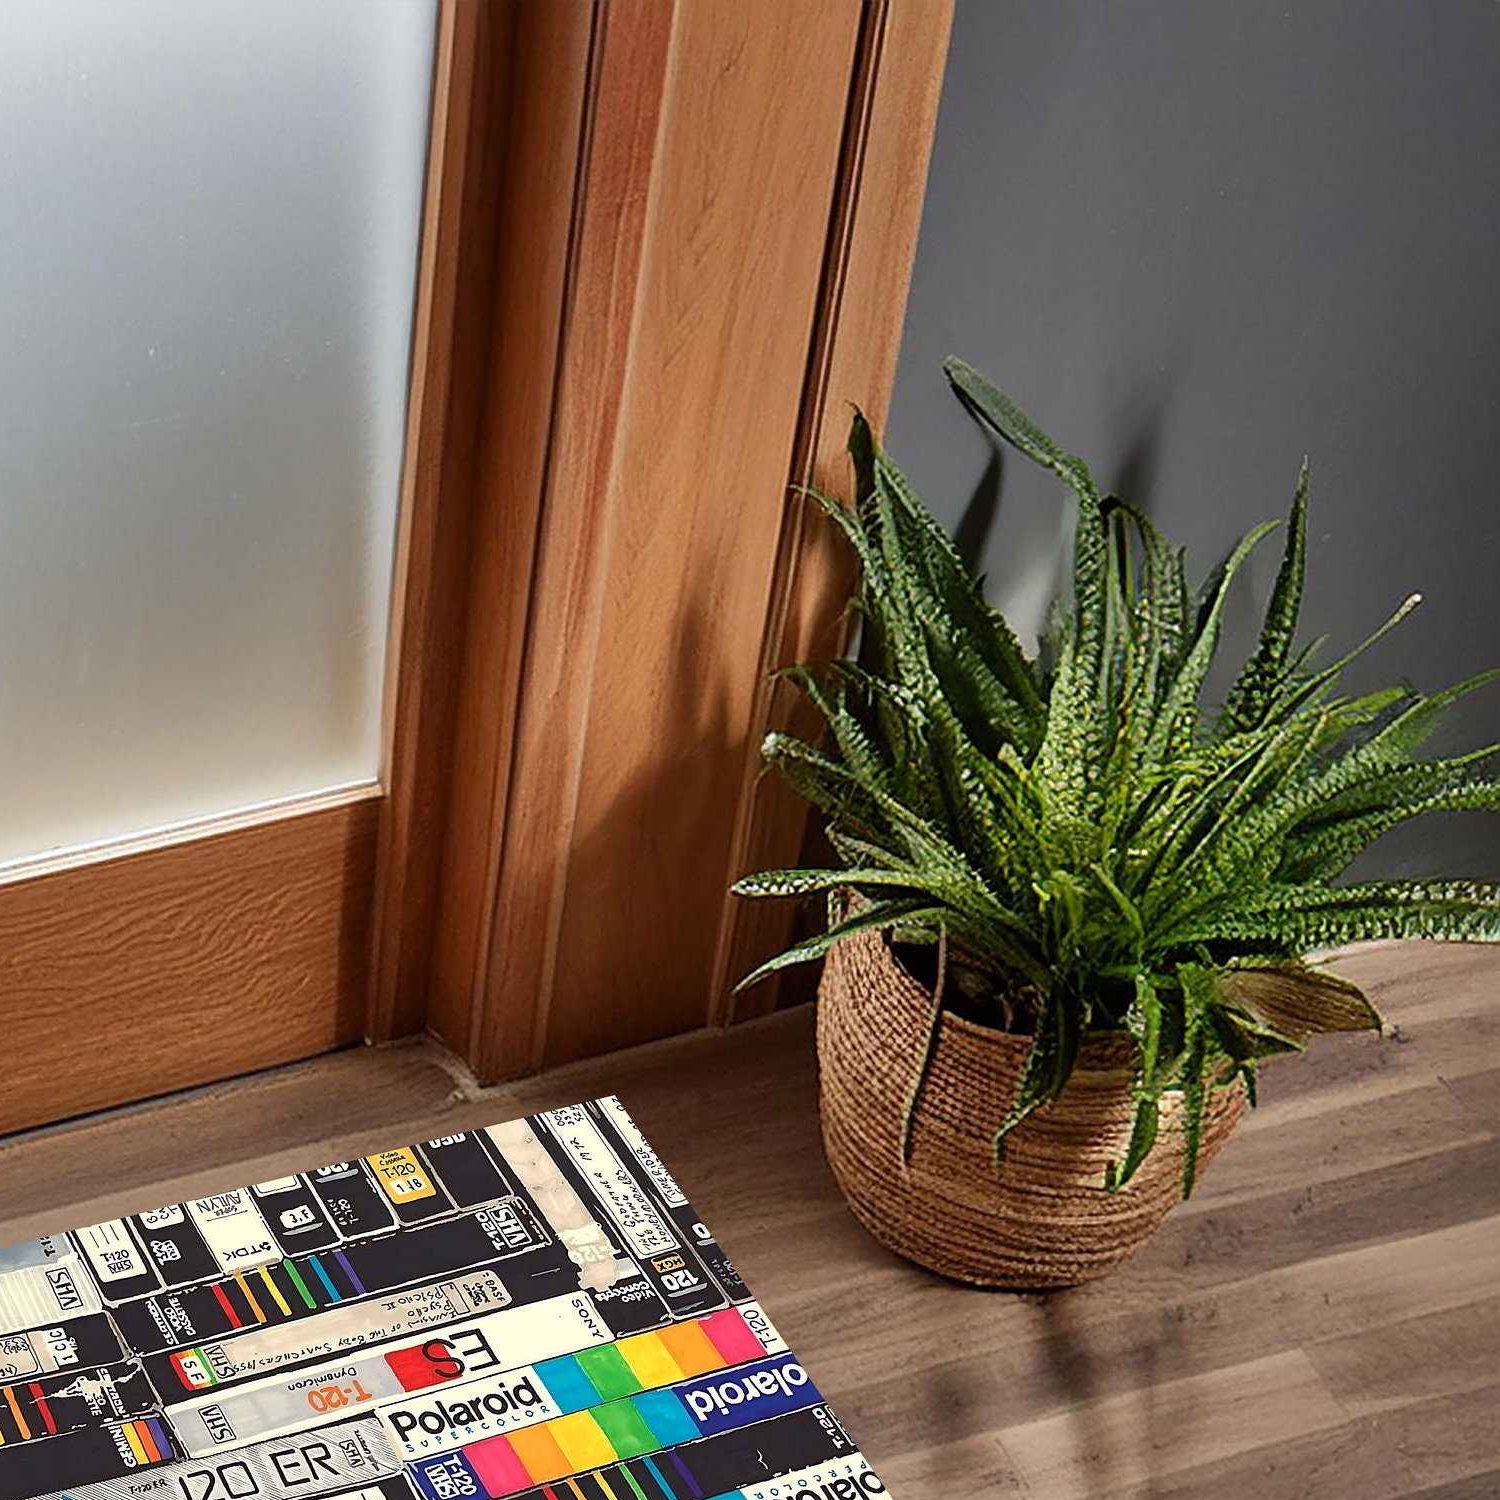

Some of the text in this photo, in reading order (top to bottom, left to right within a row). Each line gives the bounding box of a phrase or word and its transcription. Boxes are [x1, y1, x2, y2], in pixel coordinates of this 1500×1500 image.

[380, 1161, 416, 1179] T-120
[474, 1210, 505, 1251] T-120
[489, 1206, 530, 1246] VHS
[47, 1270, 82, 1307] VHS
[659, 1268, 699, 1291] 120
[571, 1298, 604, 1338] SONY
[741, 1308, 778, 1348] T-120
[417, 1327, 500, 1381] ES
[286, 1366, 357, 1391] Dynamicron
[306, 1379, 372, 1412] T-120
[684, 1362, 808, 1421] olaroid
[199, 1405, 235, 1443] VHS
[387, 1375, 542, 1442] Polaroid
[811, 1407, 845, 1449] T-120
[107, 1422, 140, 1468] GEMINI
[267, 1441, 340, 1487] ER
[339, 1439, 364, 1466] VHS
[442, 1453, 477, 1496] T-120
